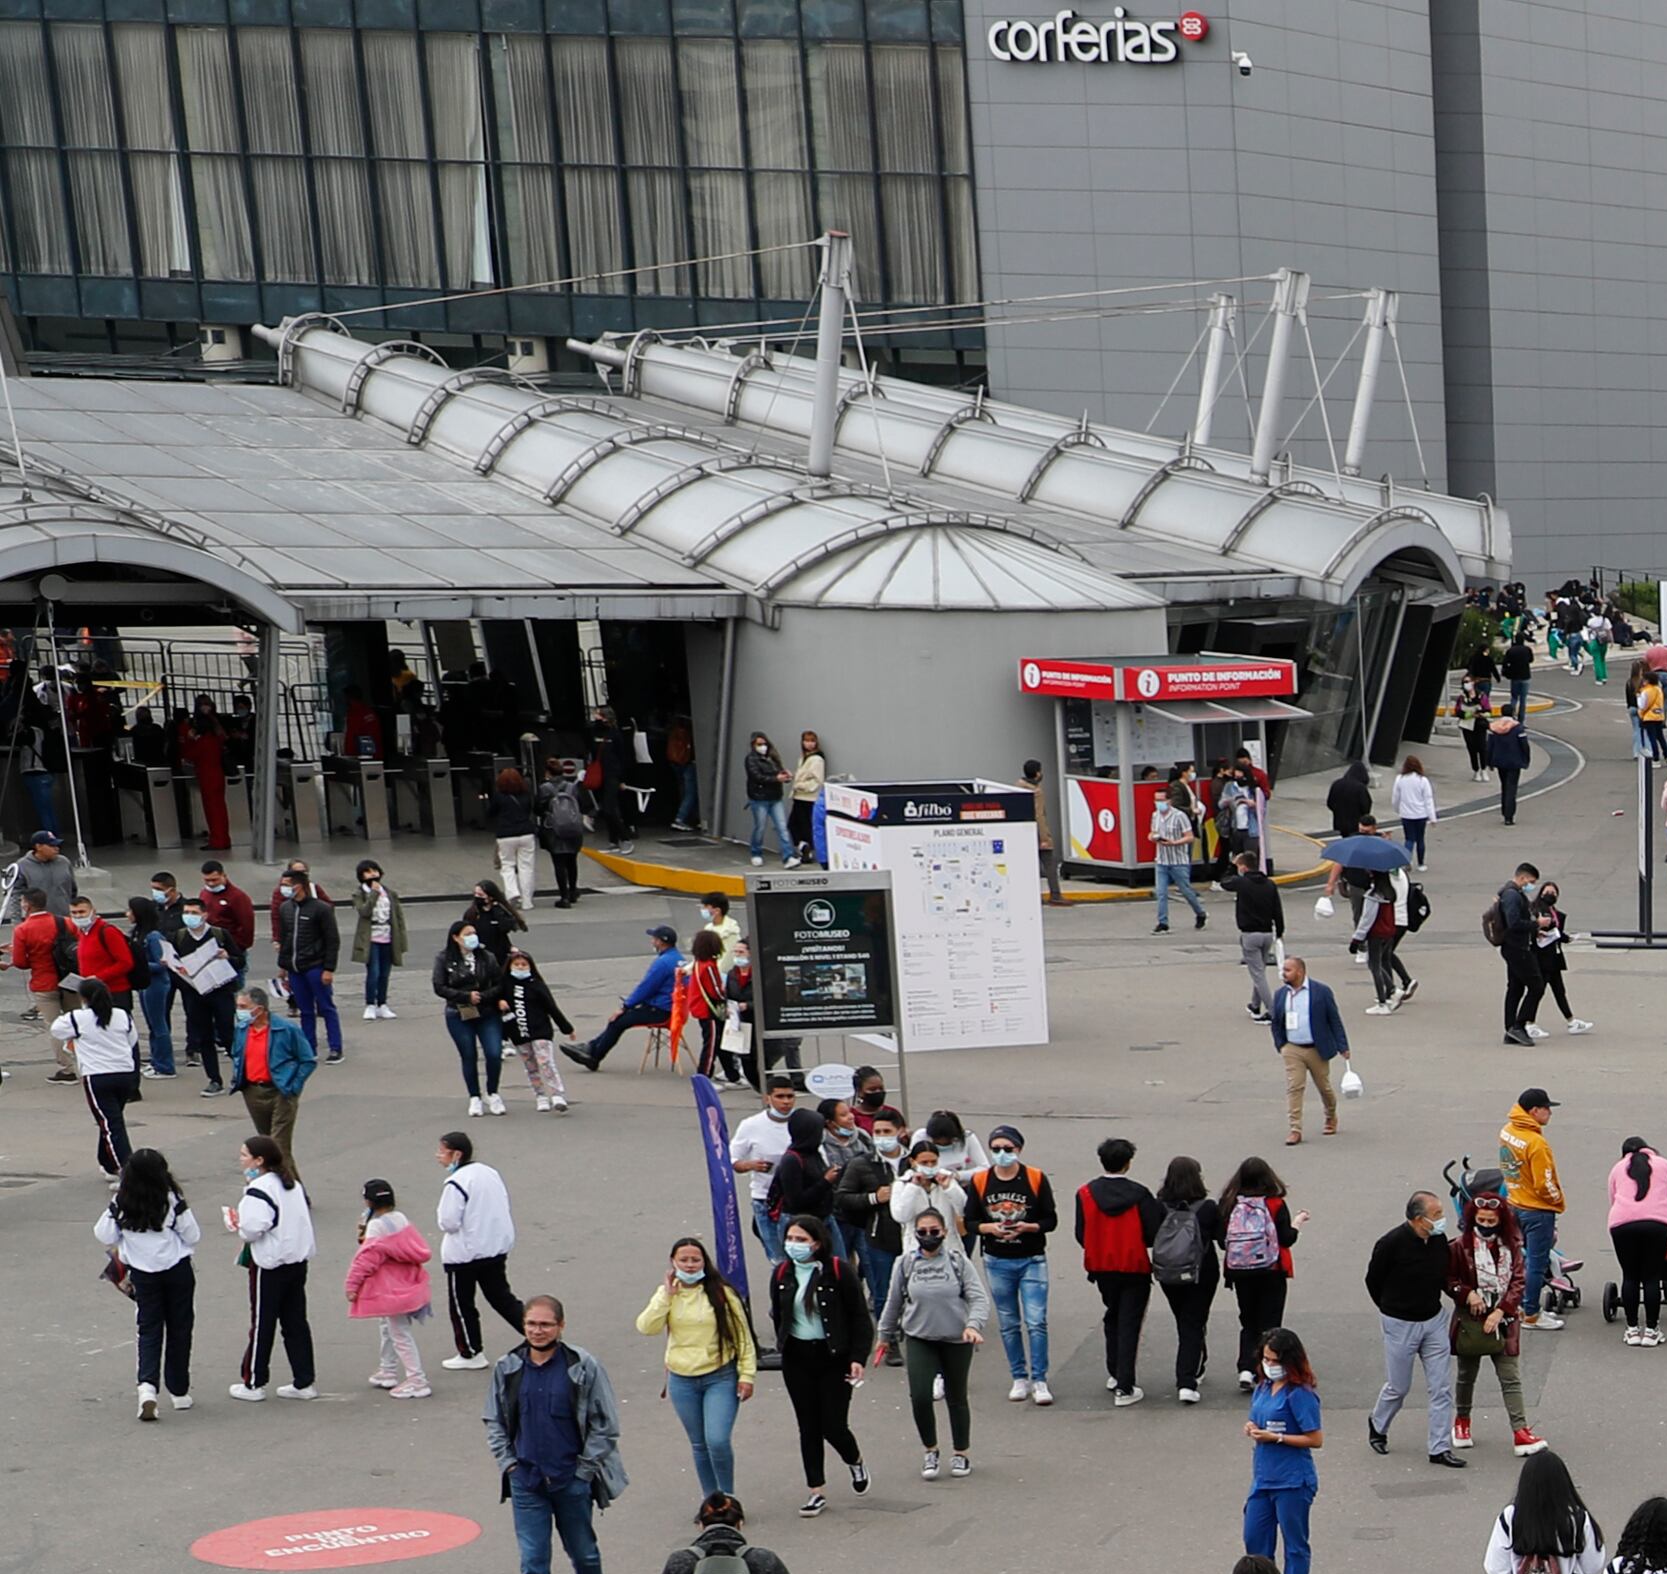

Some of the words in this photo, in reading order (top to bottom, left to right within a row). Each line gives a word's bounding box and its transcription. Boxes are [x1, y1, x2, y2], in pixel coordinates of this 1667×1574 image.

[988, 6, 1179, 62] corferias
[1042, 669, 1060, 680] PUNTO
[1060, 671, 1070, 681] DE
[1071, 672, 1112, 684] INFORMACIÓN
[1168, 671, 1199, 683] PUNTO
[1201, 670, 1215, 682] DE
[1216, 668, 1282, 682] INFORMACIÓN
[1168, 682, 1217, 693] INFORMATION
[1218, 681, 1242, 691] POINT
[933, 829, 955, 838] PLANO
[957, 827, 985, 837] GENERAL
[773, 878, 829, 888] FOTOMUSEO
[794, 929, 850, 939] FOTOMUSEO
[514, 984, 525, 999] IN
[515, 1000, 530, 1038] HOUSE
[284, 1524, 379, 1542] PUNTO
[264, 1529, 431, 1557] ENCUENTRO
